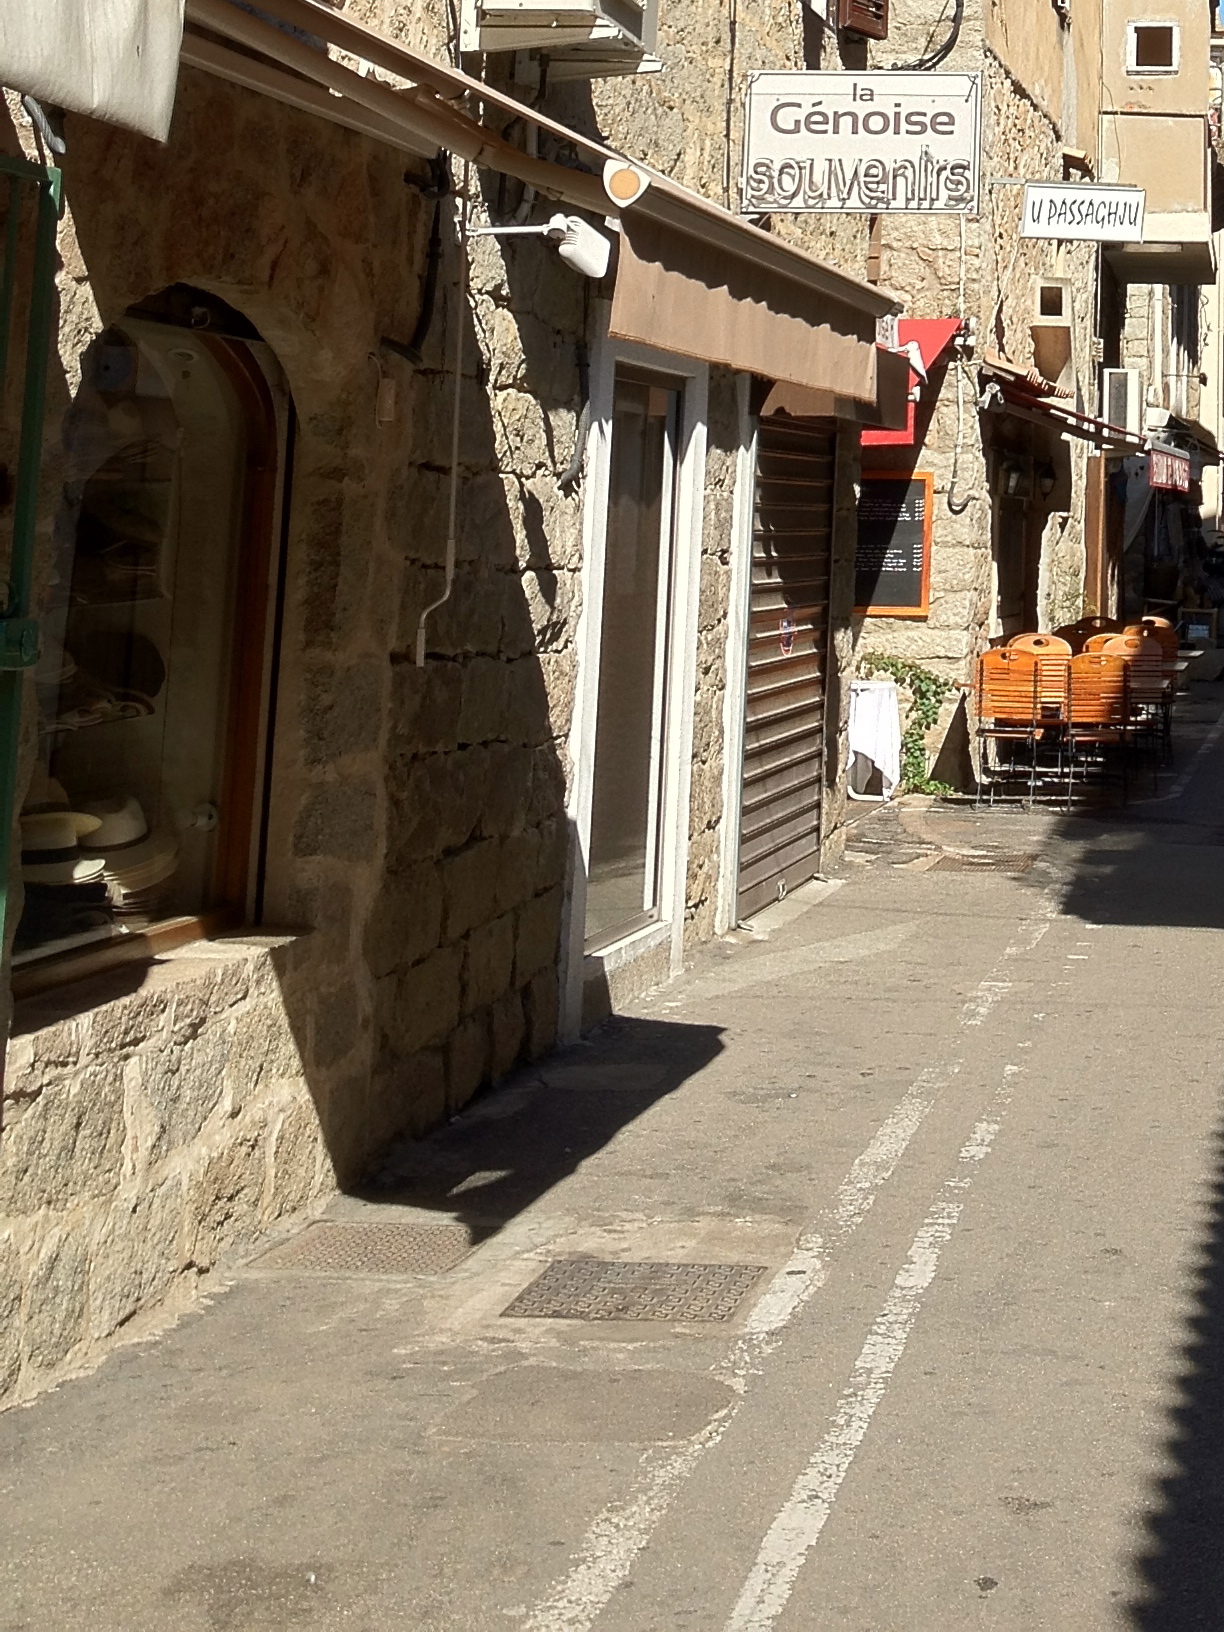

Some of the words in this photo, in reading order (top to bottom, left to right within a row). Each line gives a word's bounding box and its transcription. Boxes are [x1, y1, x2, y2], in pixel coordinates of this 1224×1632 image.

[852, 82, 875, 102] la
[769, 100, 956, 136] Génoise
[748, 144, 974, 206] souvenirs
[1031, 197, 1044, 225] U
[1047, 197, 1140, 230] PASSAGHJU
